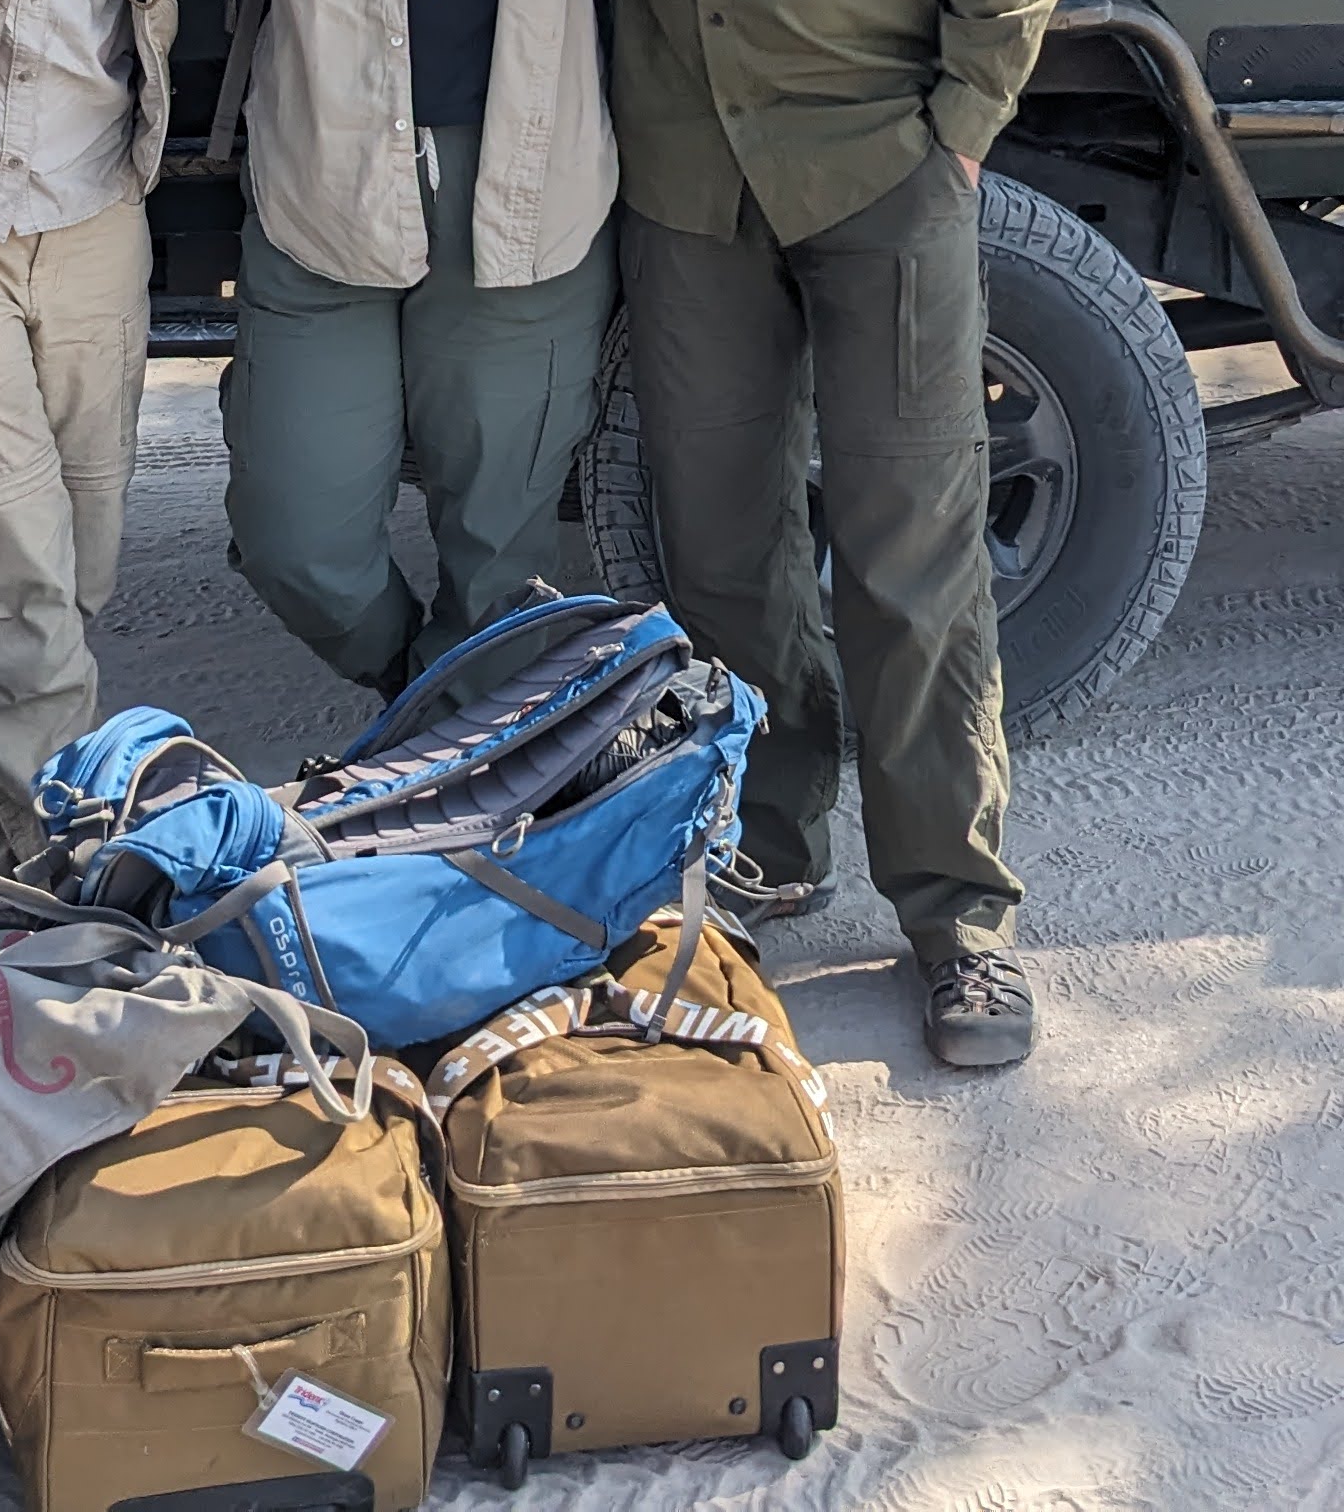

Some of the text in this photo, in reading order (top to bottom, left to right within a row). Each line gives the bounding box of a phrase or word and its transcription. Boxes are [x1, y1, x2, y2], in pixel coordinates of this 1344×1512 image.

[269, 916, 313, 1001] ospre
[463, 985, 581, 1064] LIFE
[629, 988, 768, 1044] WILD
